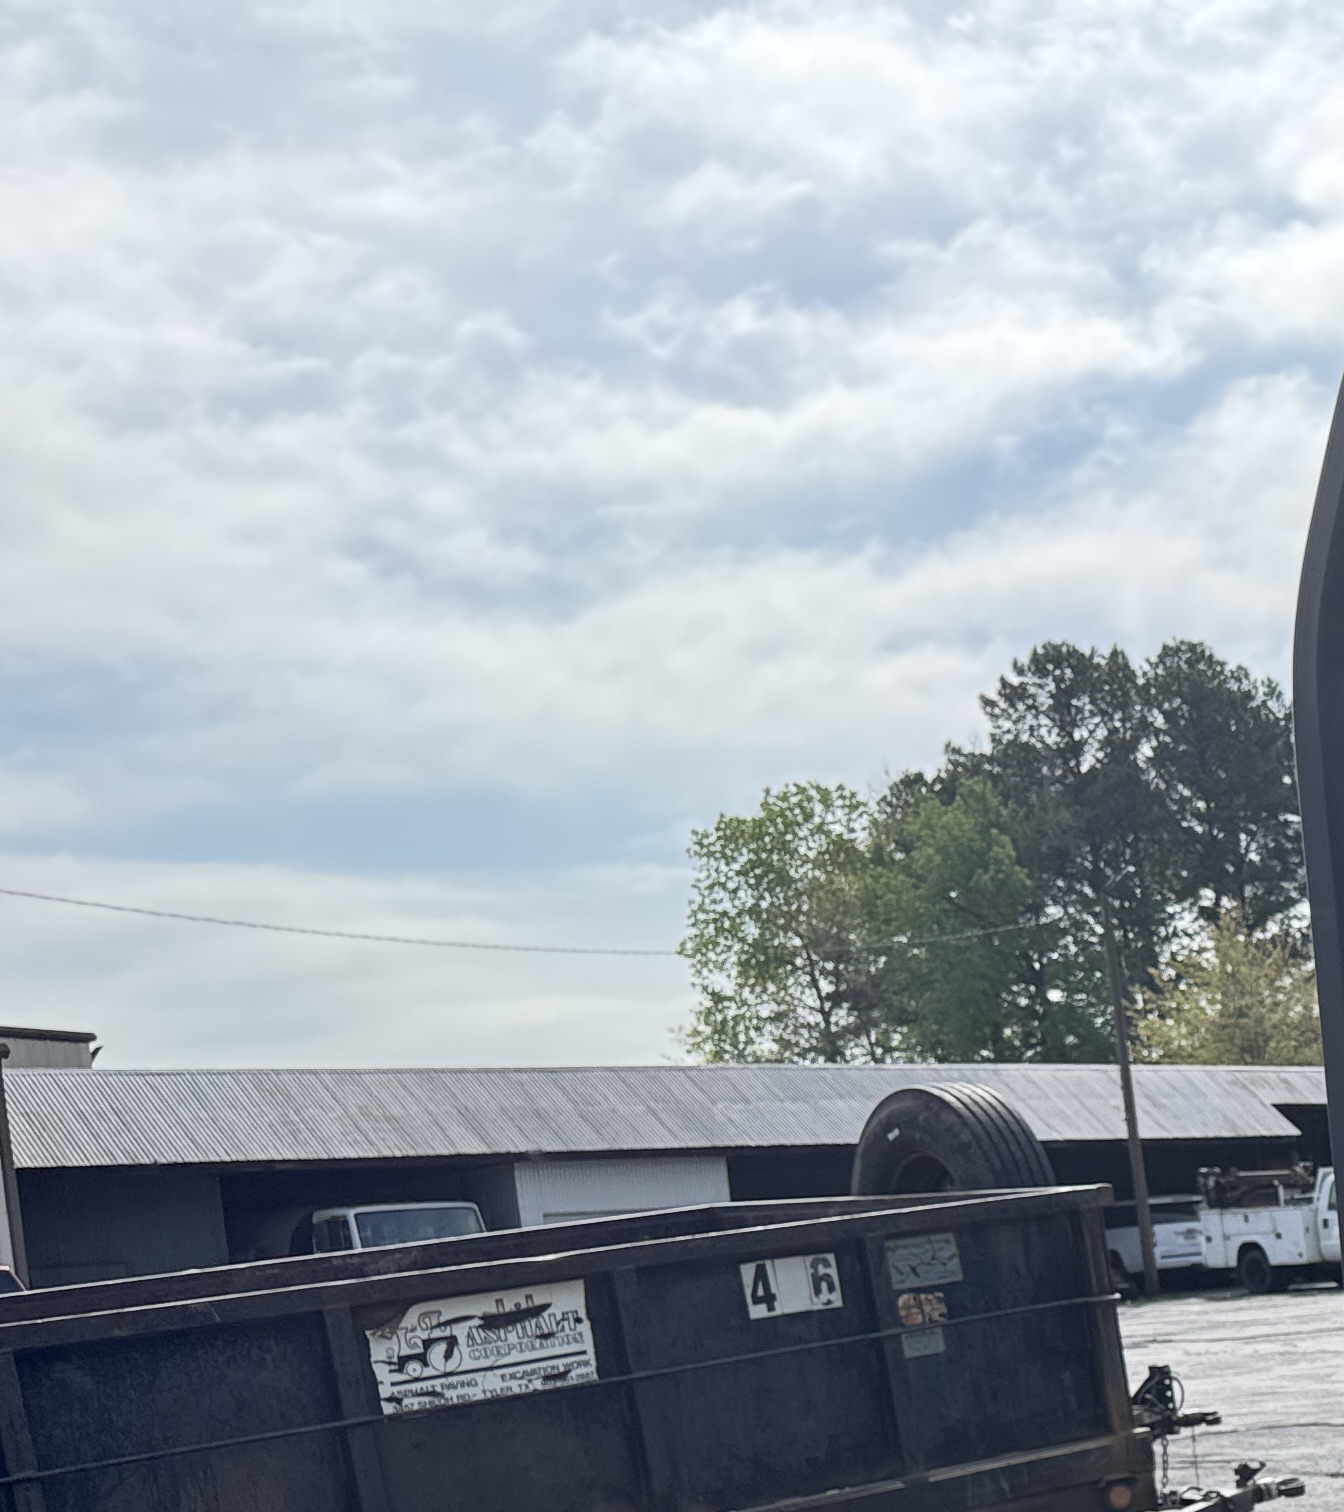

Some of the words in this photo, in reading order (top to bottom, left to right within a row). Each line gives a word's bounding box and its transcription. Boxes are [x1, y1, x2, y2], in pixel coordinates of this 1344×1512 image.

[750, 1262, 778, 1313] 4
[466, 1309, 581, 1349] ASPHALT
[467, 1331, 586, 1362] CORPORATION
[561, 1358, 593, 1373] WORK
[439, 1377, 479, 1391] PAVING
